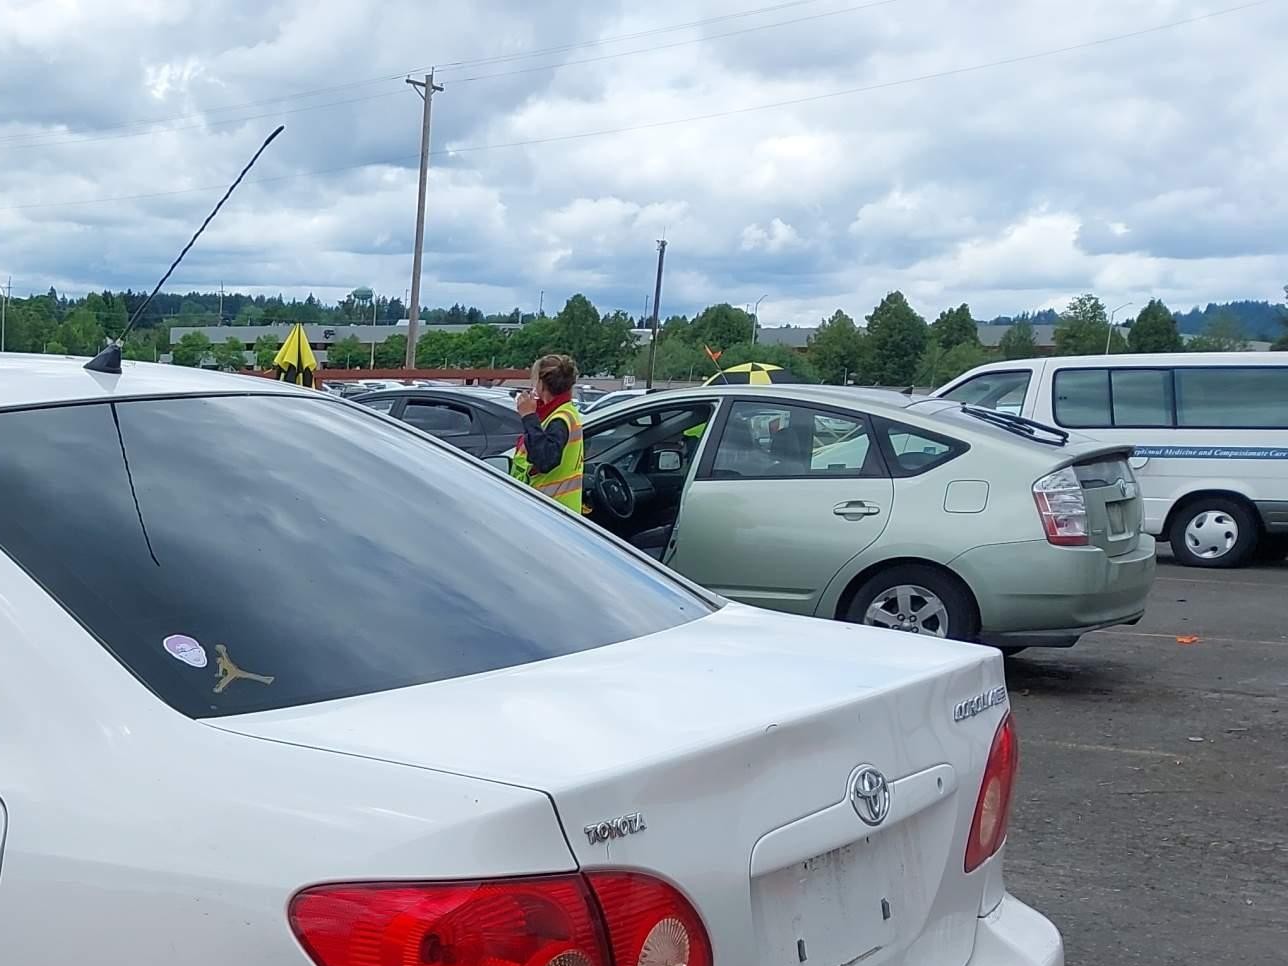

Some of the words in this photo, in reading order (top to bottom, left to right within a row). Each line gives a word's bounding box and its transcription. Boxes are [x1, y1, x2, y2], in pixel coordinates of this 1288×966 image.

[1164, 448, 1197, 456] Medicine
[1198, 448, 1212, 456] and
[1214, 449, 1269, 457] Compassionate
[1270, 449, 1288, 457] Care
[584, 812, 647, 845] TOYOTA
